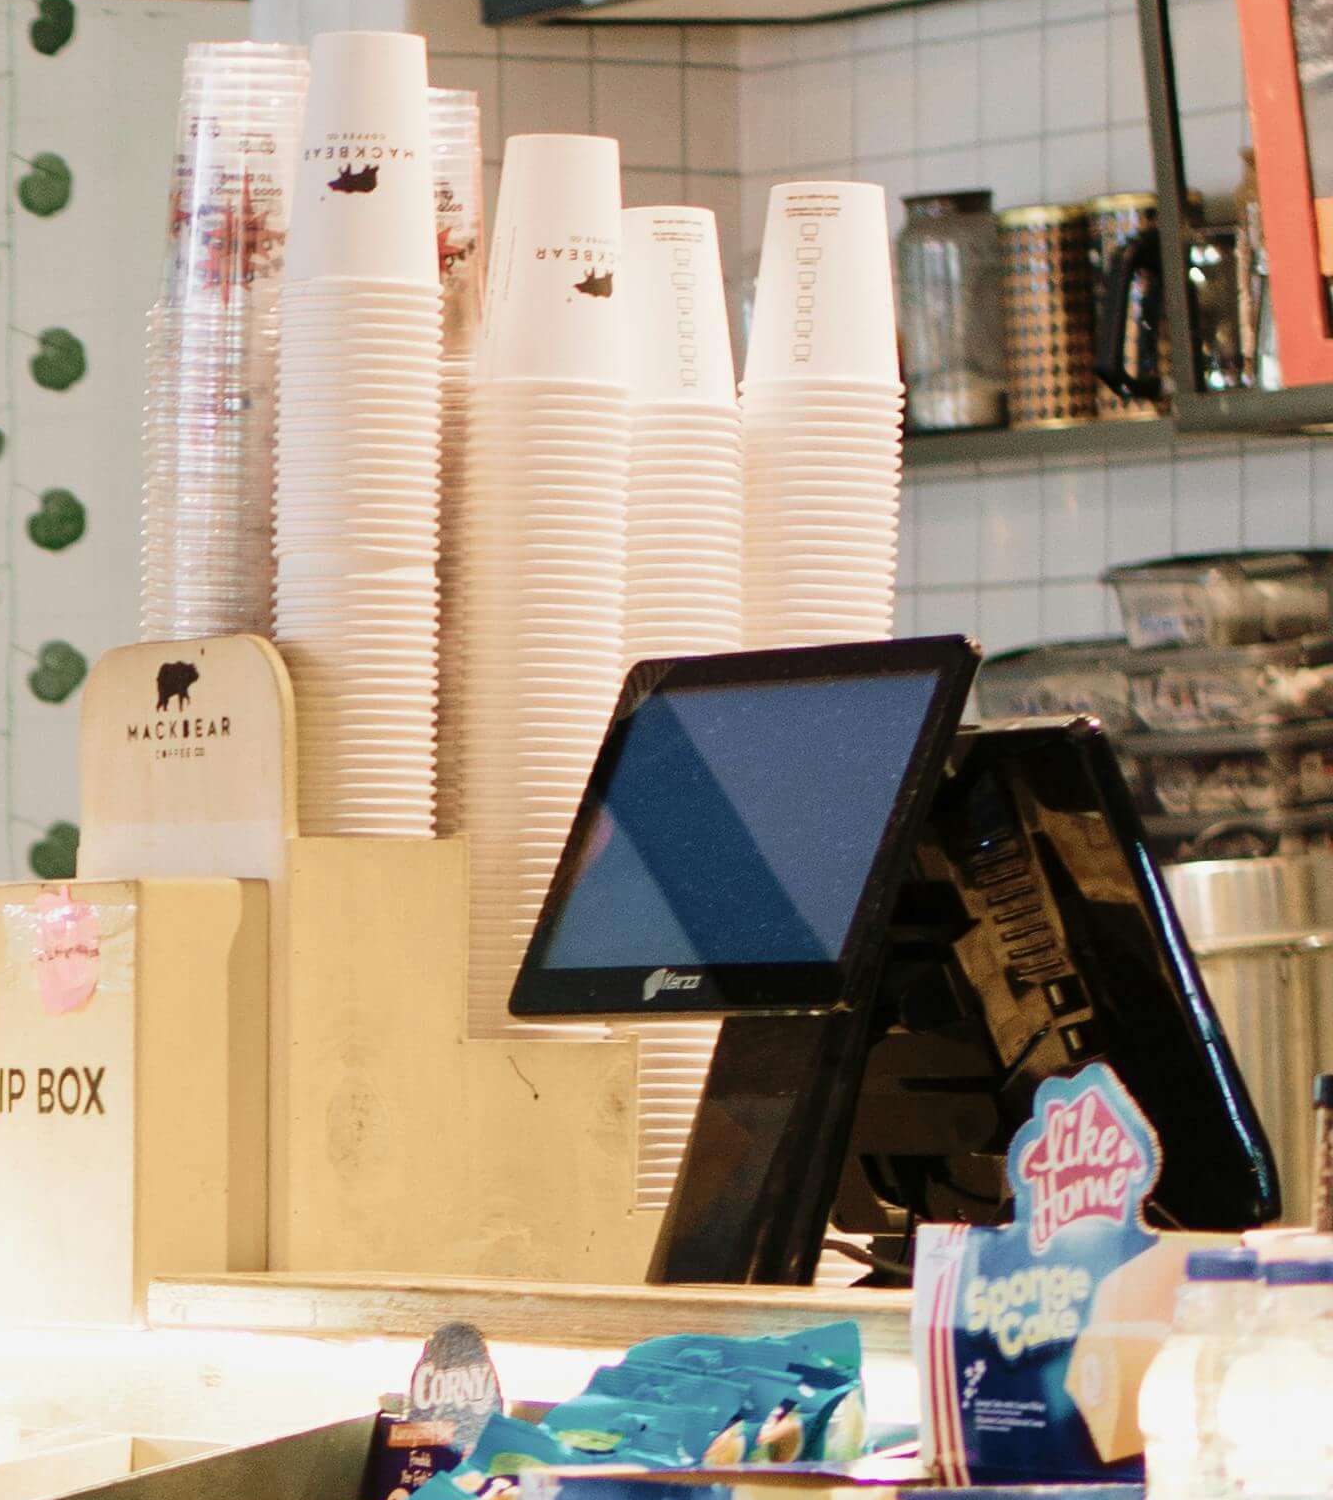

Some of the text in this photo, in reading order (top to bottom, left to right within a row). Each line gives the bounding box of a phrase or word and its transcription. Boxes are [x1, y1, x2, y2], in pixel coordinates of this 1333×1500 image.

[128, 716, 231, 740] MACKBEAR
[38, 1065, 106, 1116] BOX
[1032, 1168, 1129, 1243] Home
[965, 1265, 1091, 1333] Sponge
[998, 1307, 1080, 1361] Cake
